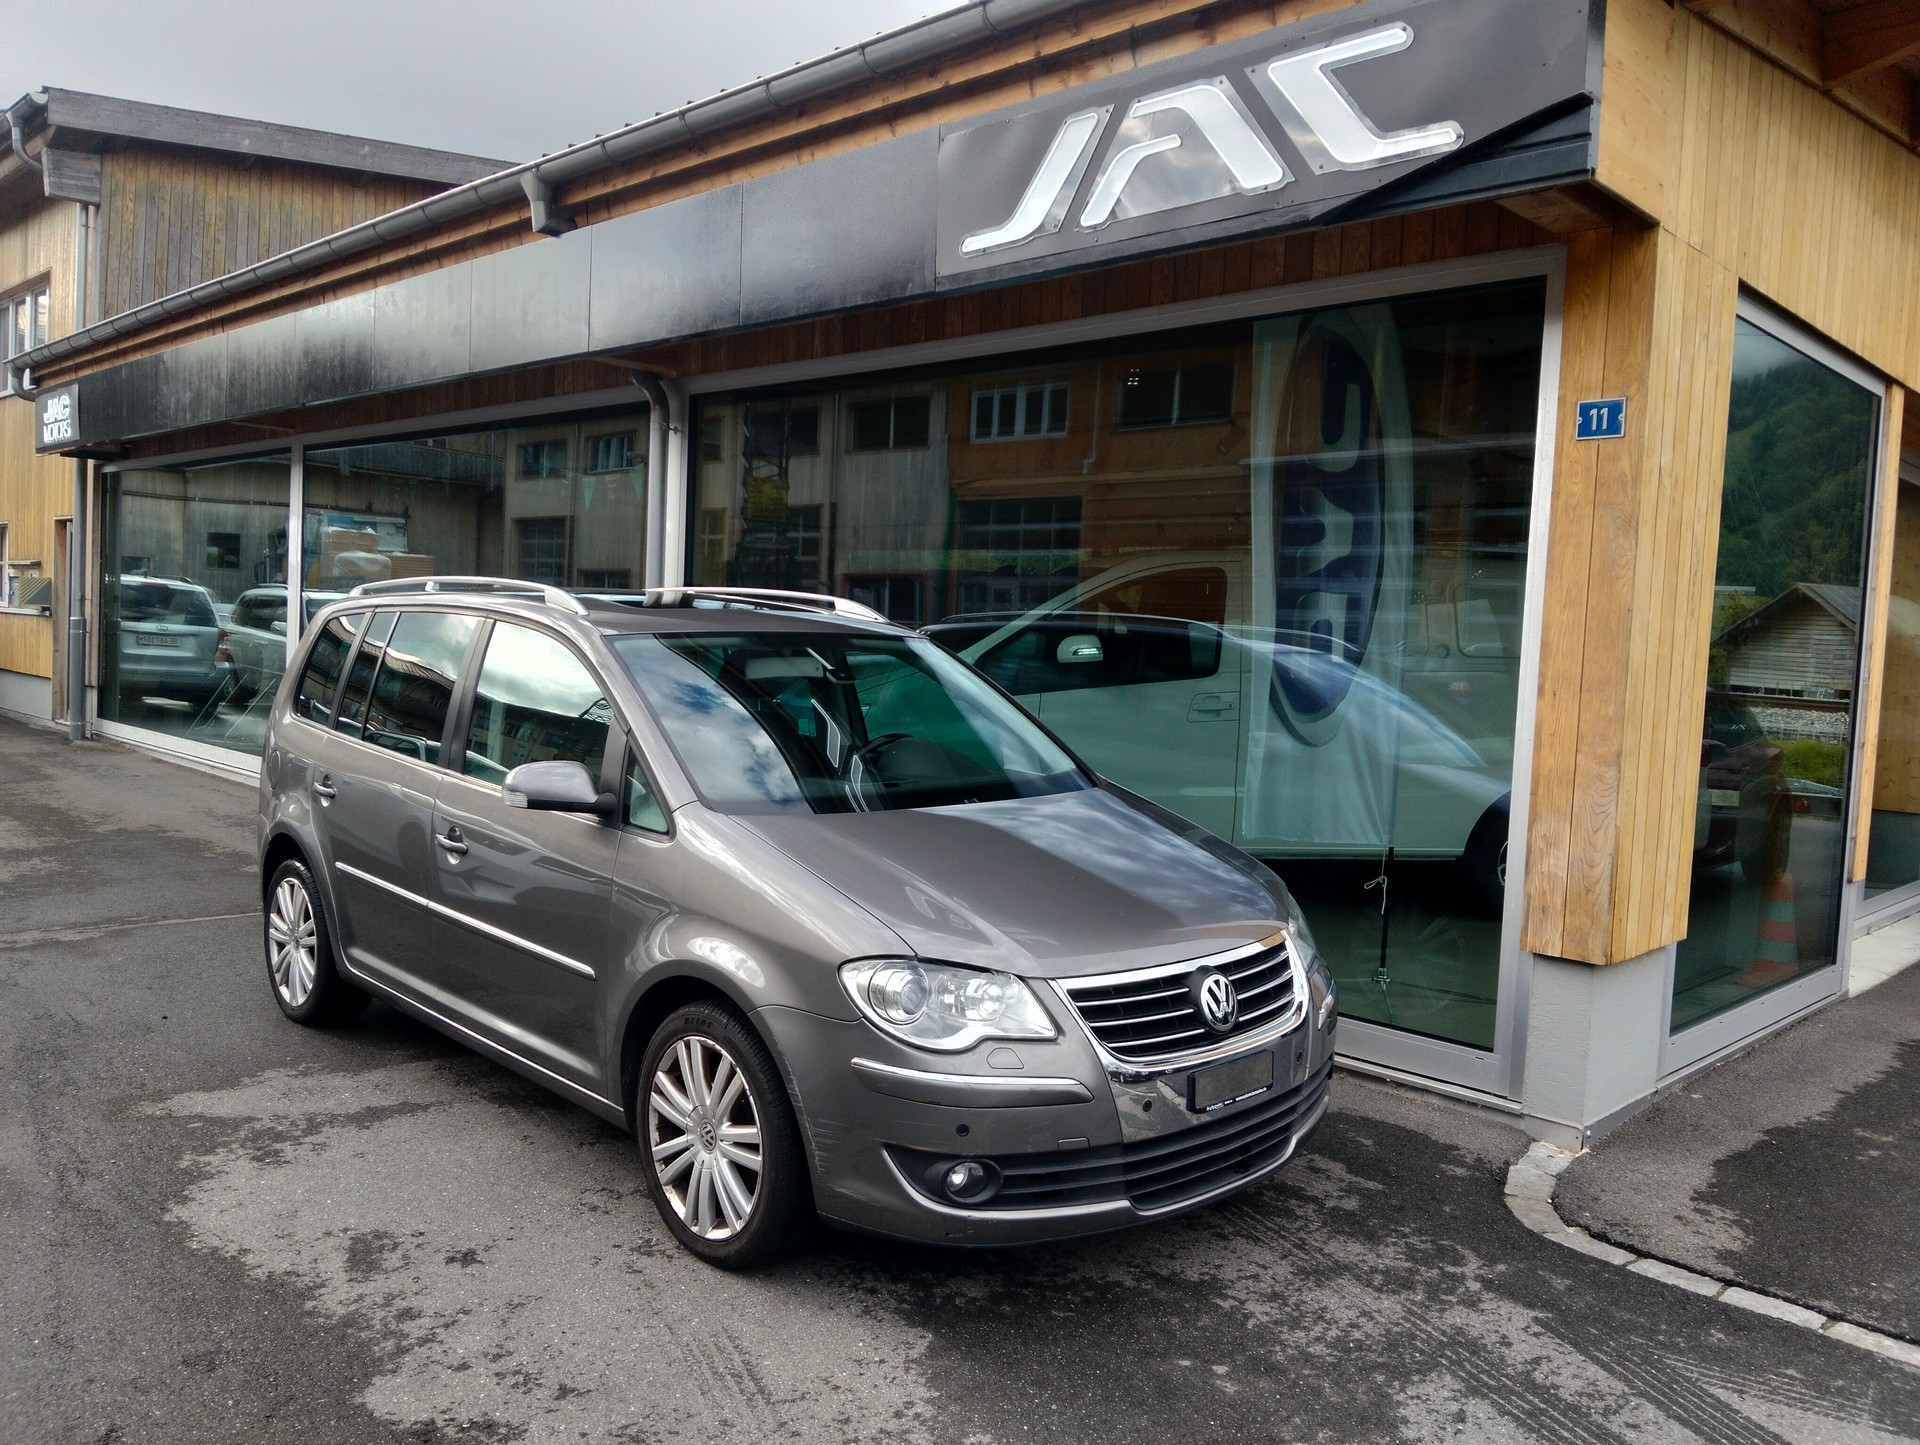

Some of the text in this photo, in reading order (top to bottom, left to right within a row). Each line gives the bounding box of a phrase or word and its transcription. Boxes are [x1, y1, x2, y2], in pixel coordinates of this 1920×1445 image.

[961, 22, 1464, 257] JAC
[43, 394, 70, 423] JAC
[1588, 407, 1609, 431] 11
[43, 420, 71, 442] MOTORS
